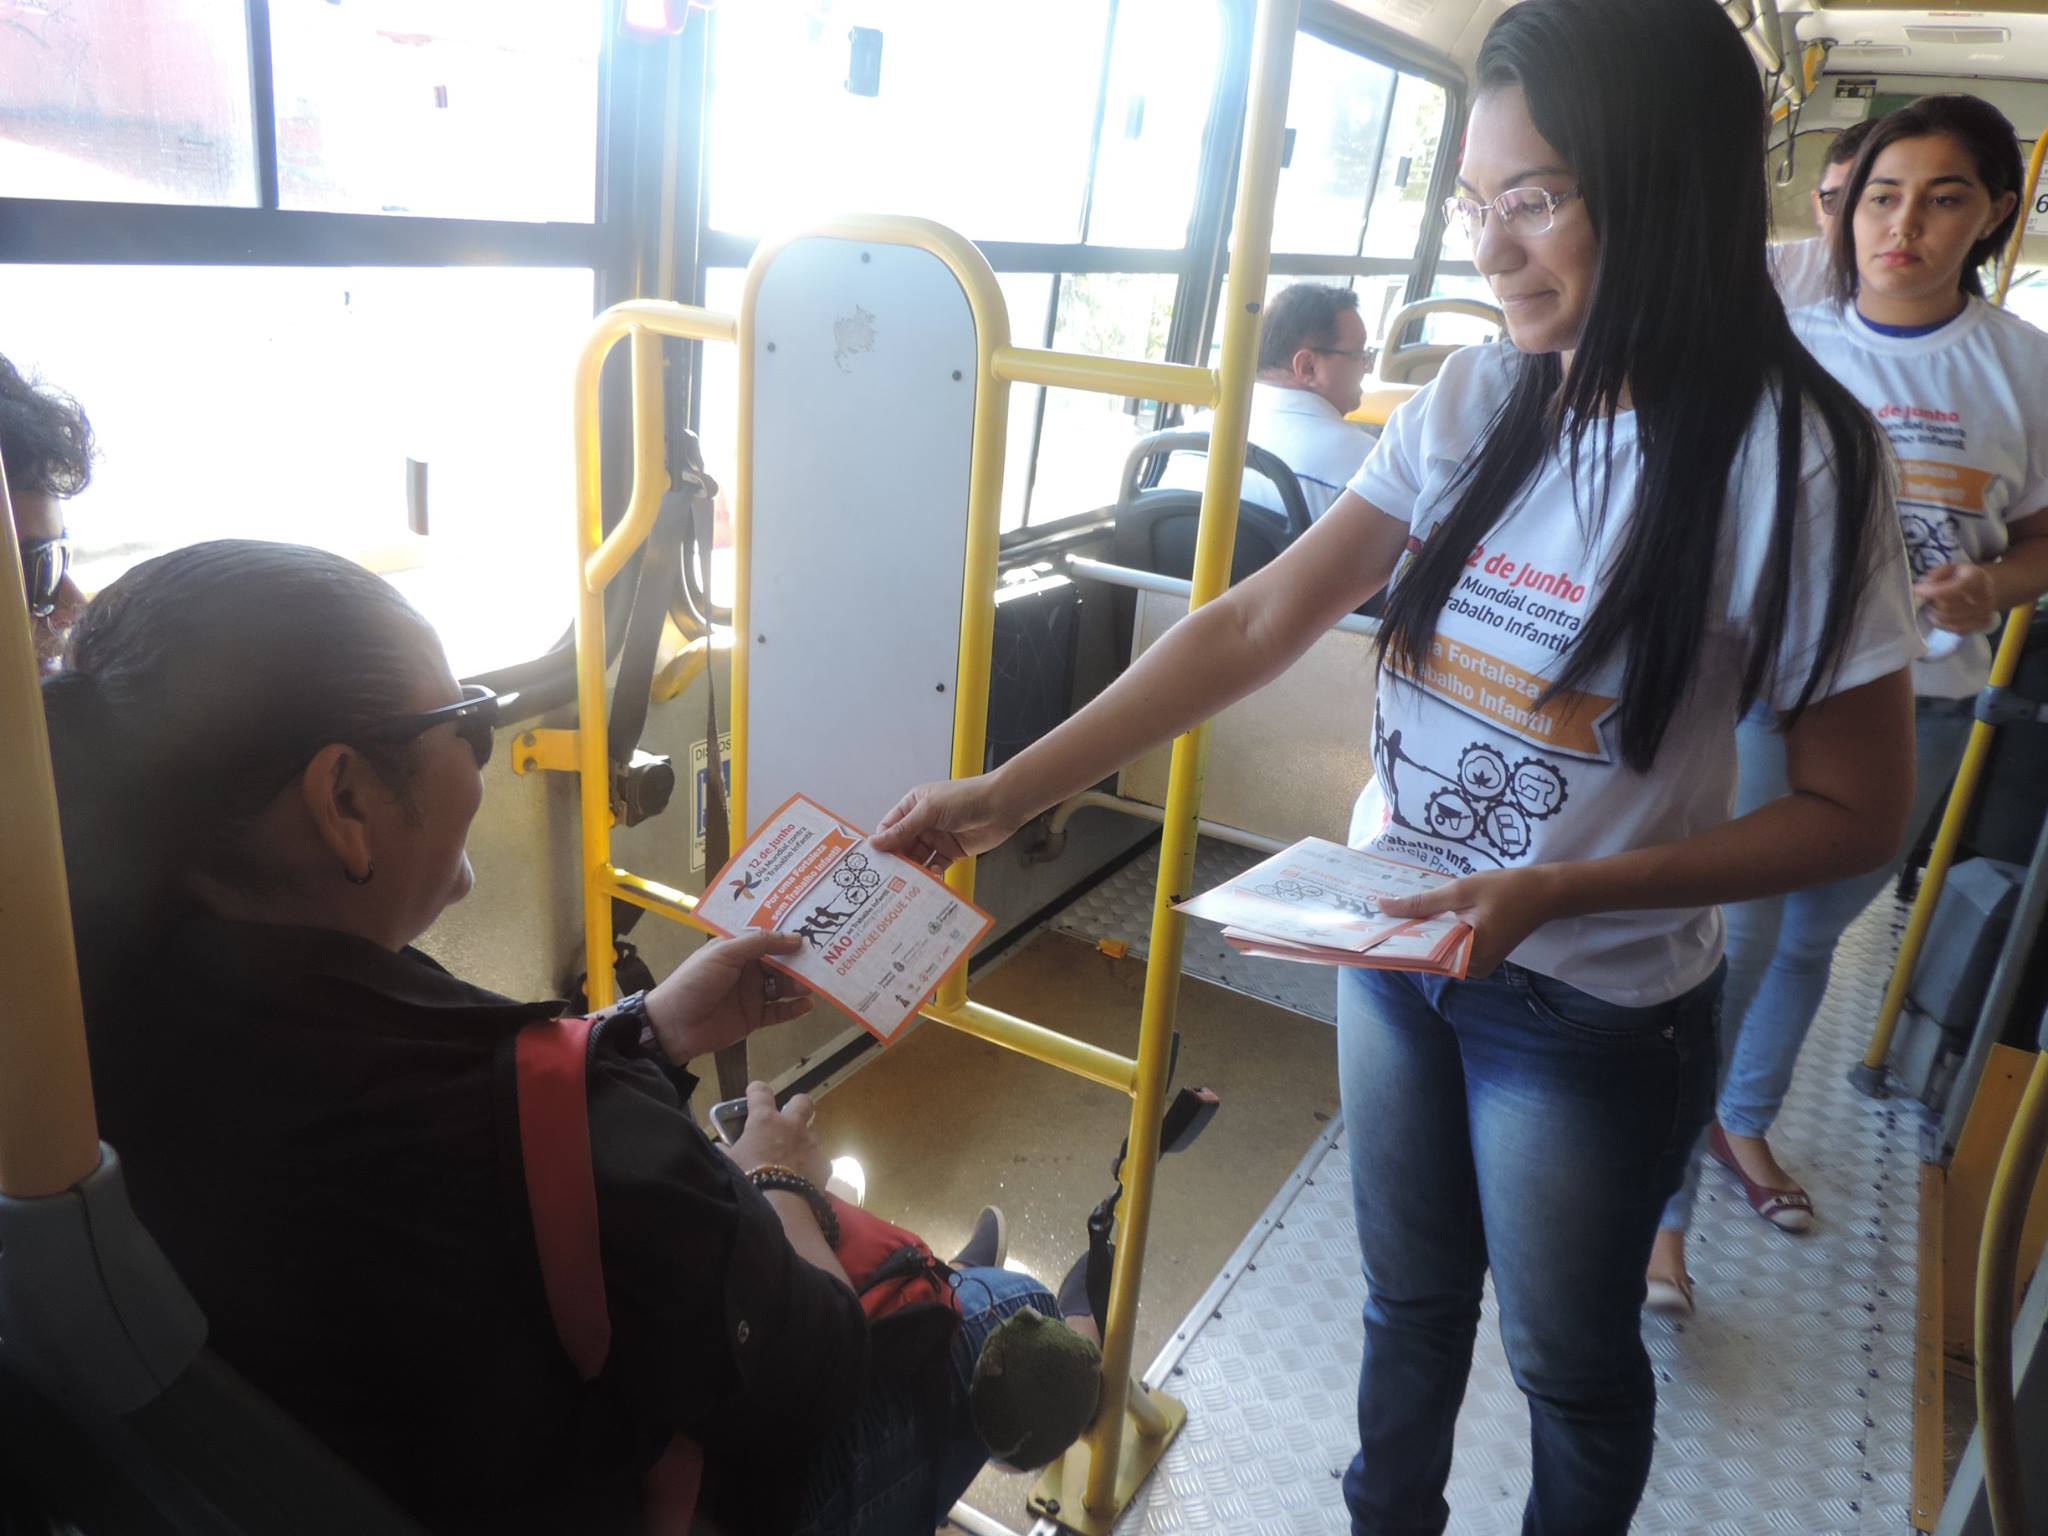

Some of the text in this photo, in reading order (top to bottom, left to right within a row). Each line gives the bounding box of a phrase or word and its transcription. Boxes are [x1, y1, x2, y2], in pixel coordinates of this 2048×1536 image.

[1465, 544, 1586, 604] 2 de Junho
[1443, 597, 1573, 655] rabalho Infantil
[1460, 576, 1582, 632] Mundial contra
[1419, 664, 1553, 735] abalho Infantil
[1448, 644, 1542, 700] Fortaleza
[748, 823, 796, 869] 12 de Junho
[765, 843, 789, 867] Mundial
[787, 826, 807, 844] contra
[763, 844, 828, 909] Por uma Fortaleza
[771, 845, 843, 921] sem Trabalho Infantil
[876, 901, 908, 933] DISQUE
[904, 886, 921, 902] 100
[822, 935, 853, 965] NÃO
